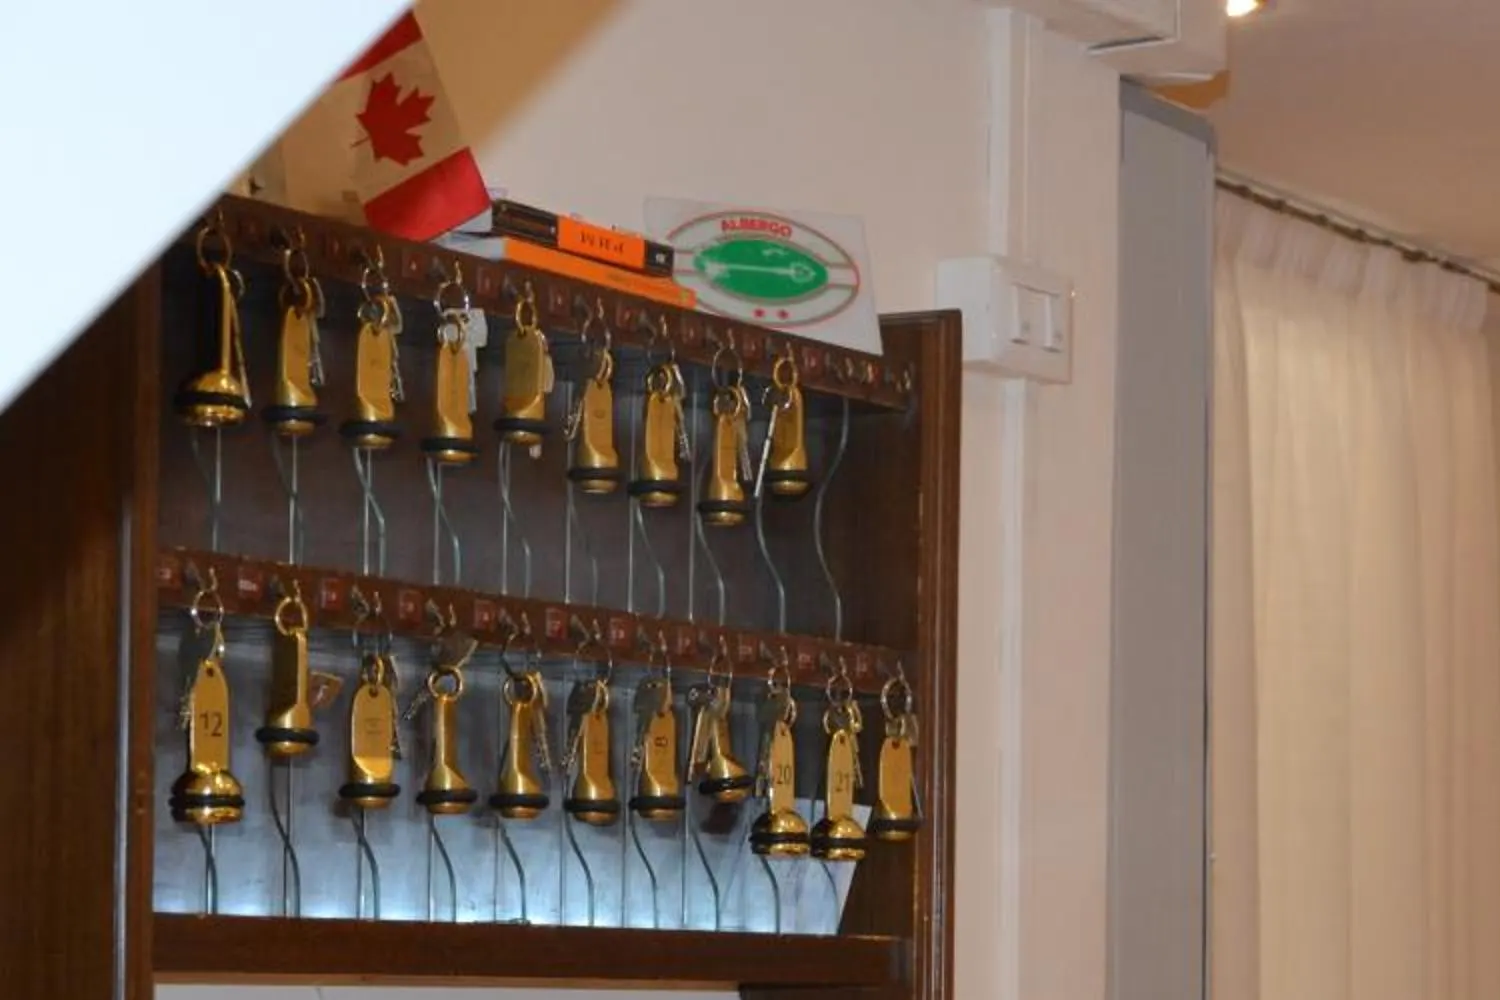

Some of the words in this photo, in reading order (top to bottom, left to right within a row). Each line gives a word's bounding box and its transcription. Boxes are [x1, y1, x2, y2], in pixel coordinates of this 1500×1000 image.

[721, 217, 793, 237] ALBERGO
[199, 710, 223, 737] 12
[776, 764, 791, 785] 20
